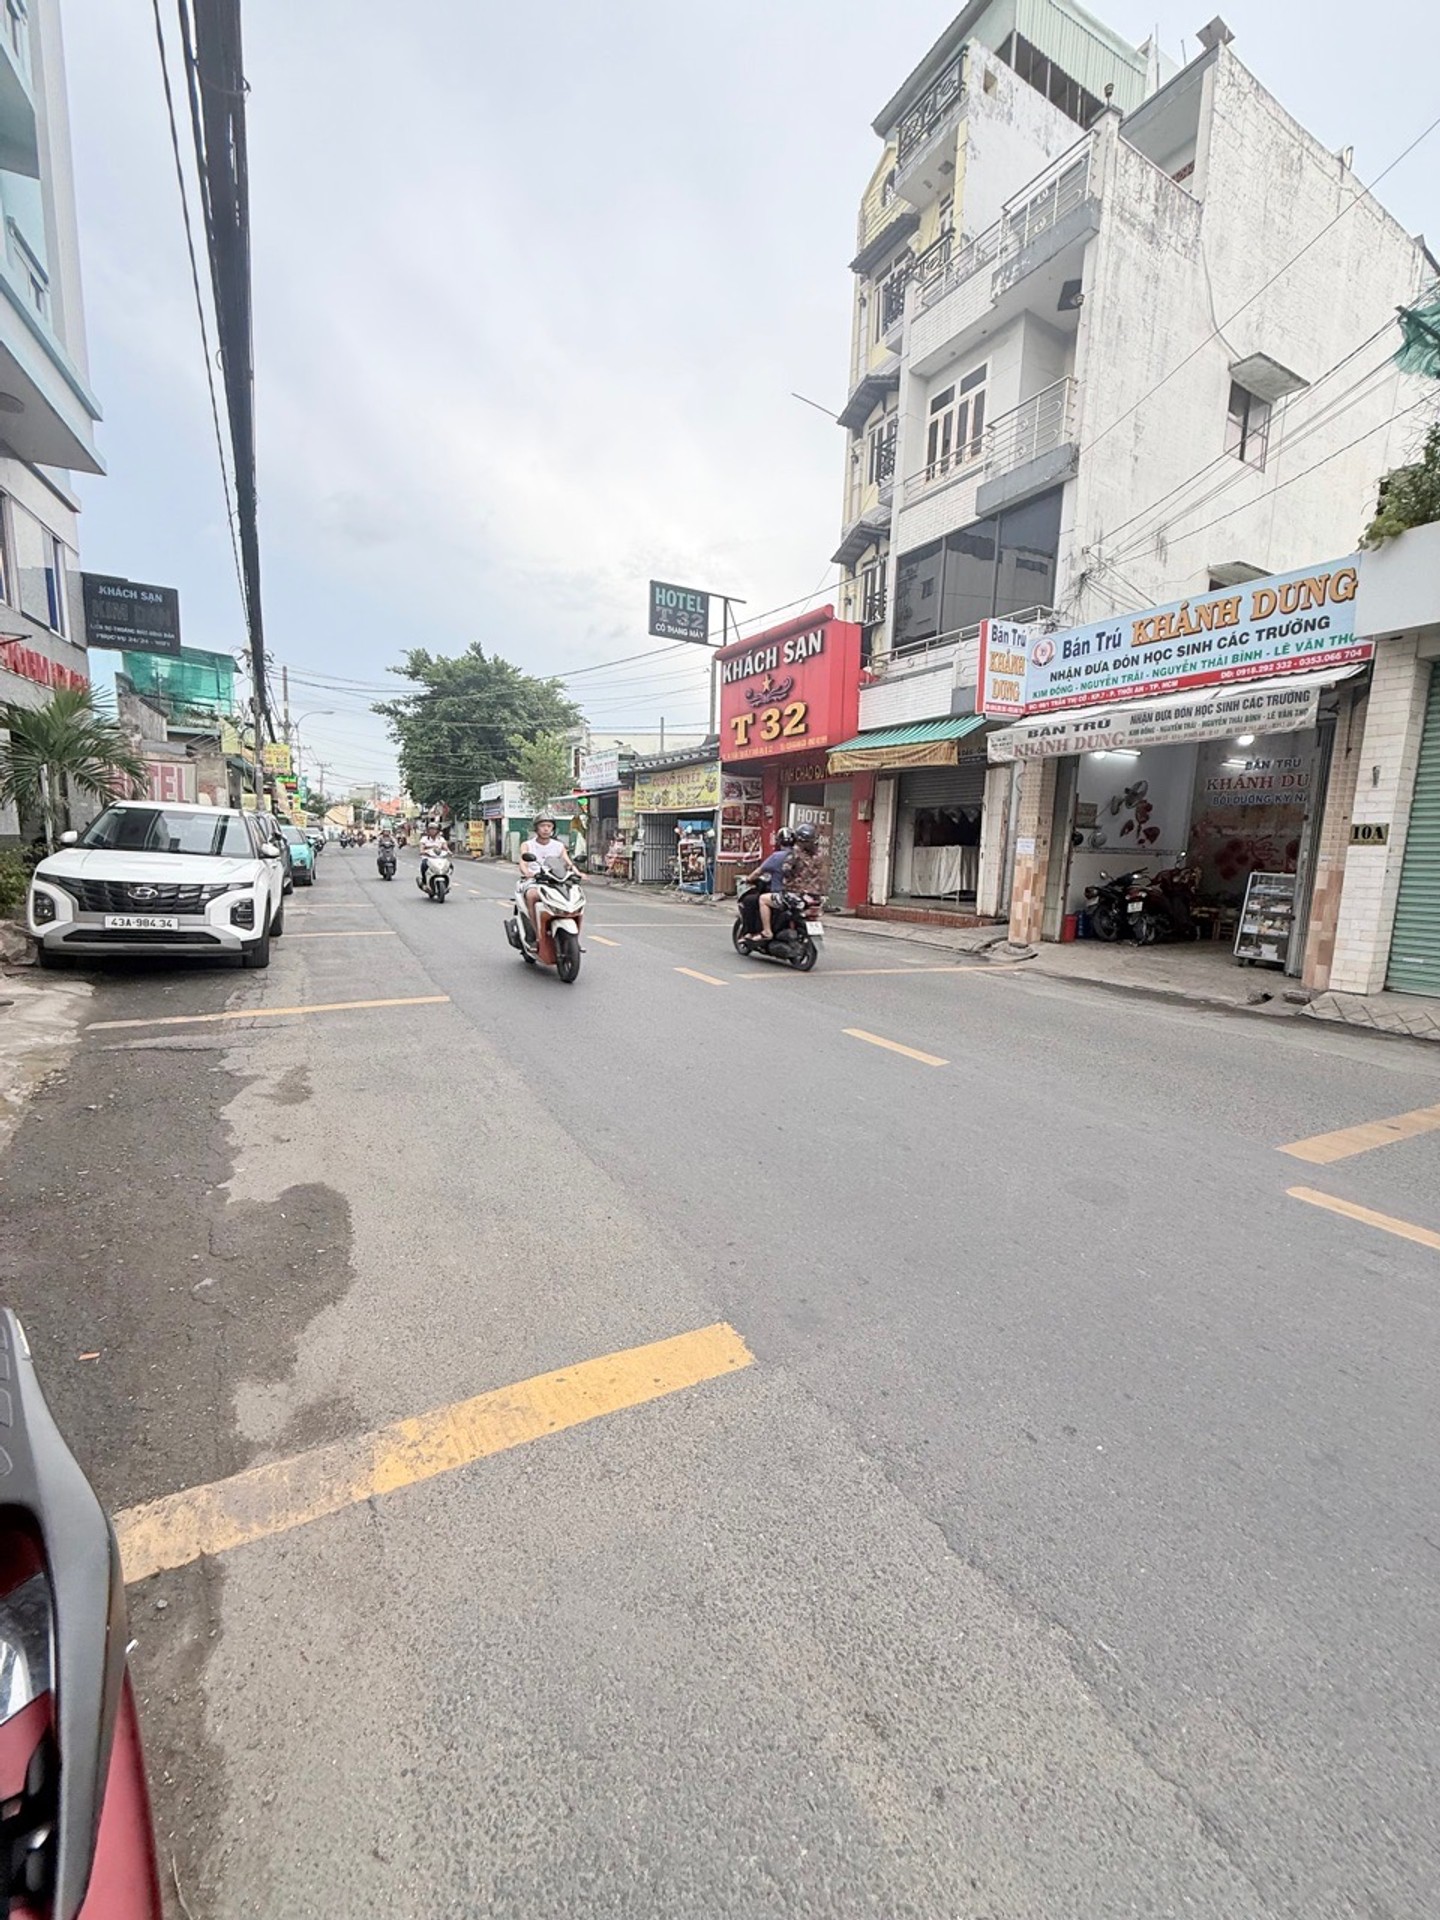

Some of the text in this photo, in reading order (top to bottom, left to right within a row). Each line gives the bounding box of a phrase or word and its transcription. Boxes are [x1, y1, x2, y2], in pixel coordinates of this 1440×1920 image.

[98, 584, 163, 603] KHÁCH SẠN
[655, 587, 705, 614] HOTEL
[655, 605, 704, 629] T 32
[1062, 567, 1358, 660] Bán Trú KHÁNH DUNG
[655, 622, 705, 639] CÓ THANG MÁY
[991, 624, 1028, 647] Bán Trú
[722, 629, 823, 684] KHÁCH SẠN
[1049, 615, 1331, 683] NHẬN ĐƯA ĐÓN HỌC SINH CÁC TRƯỜNG
[989, 649, 1026, 676] KHÁNH
[1032, 690, 1048, 699] KIM
[1080, 677, 1119, 692] NGUYỄN
[1152, 659, 1198, 678] NGUYỄN
[1201, 654, 1228, 669] THÁI
[1232, 649, 1263, 663] BÌNH
[1274, 643, 1291, 657] LÊ
[1295, 637, 1324, 652] VĂN
[991, 678, 1020, 702] DUNG
[1174, 706, 1193, 719] ĐÓN
[1194, 703, 1214, 717] HỌC
[1216, 700, 1240, 714] SINH
[1242, 696, 1263, 710] CÁC
[1266, 690, 1311, 707] TRƯỜNG
[730, 701, 807, 746] T 32
[1027, 718, 1111, 738] BÁN TRÚ
[1013, 736, 1068, 757] KHÁNH
[1074, 730, 1126, 750] DUNG
[1207, 774, 1274, 791] KHÁNH
[797, 808, 832, 825] HOTEL
[1353, 826, 1385, 840] 10A
